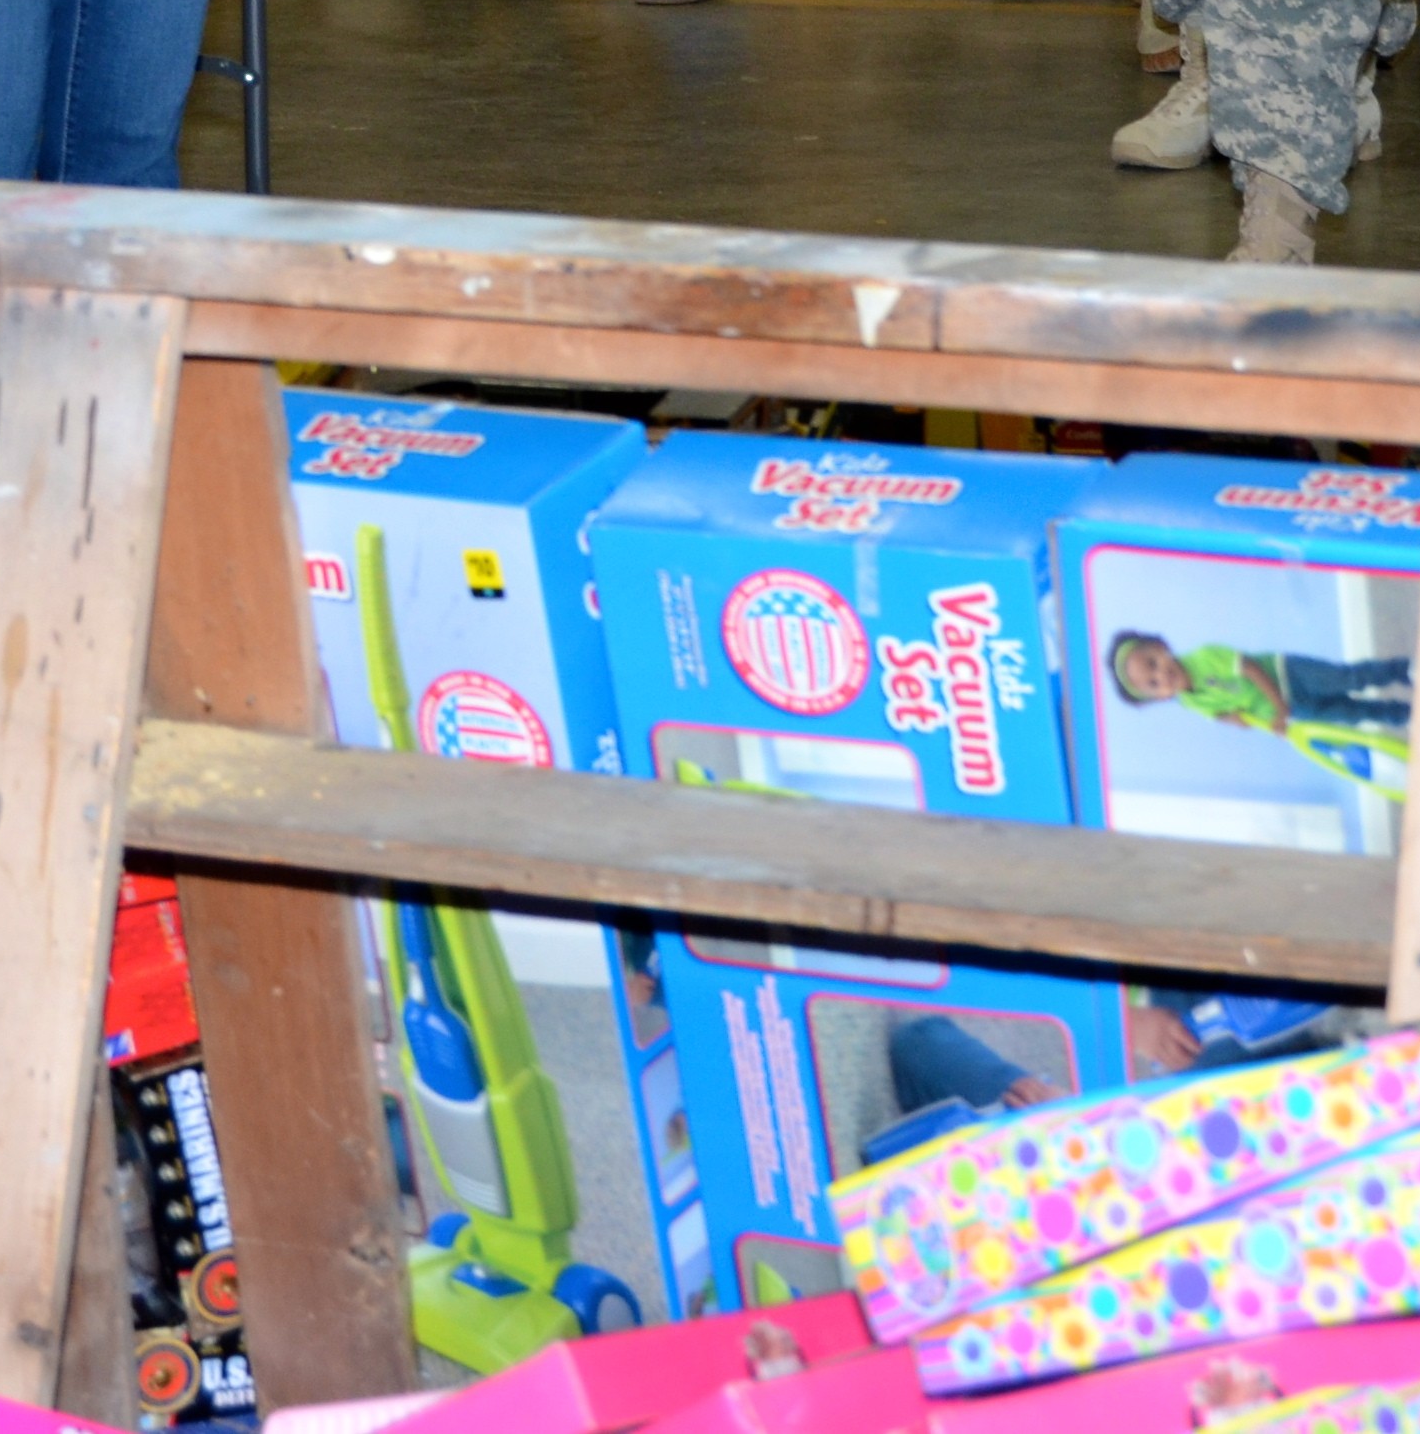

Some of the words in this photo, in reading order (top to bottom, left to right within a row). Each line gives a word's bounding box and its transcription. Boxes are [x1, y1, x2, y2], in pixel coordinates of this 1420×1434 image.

[297, 411, 486, 458] Vacuum
[302, 446, 403, 479] Set
[750, 456, 963, 505] Vacuum
[773, 495, 879, 533] Set
[877, 634, 947, 735] Set
[929, 580, 1006, 796] Vacuum
[988, 635, 1036, 713] Kidz
